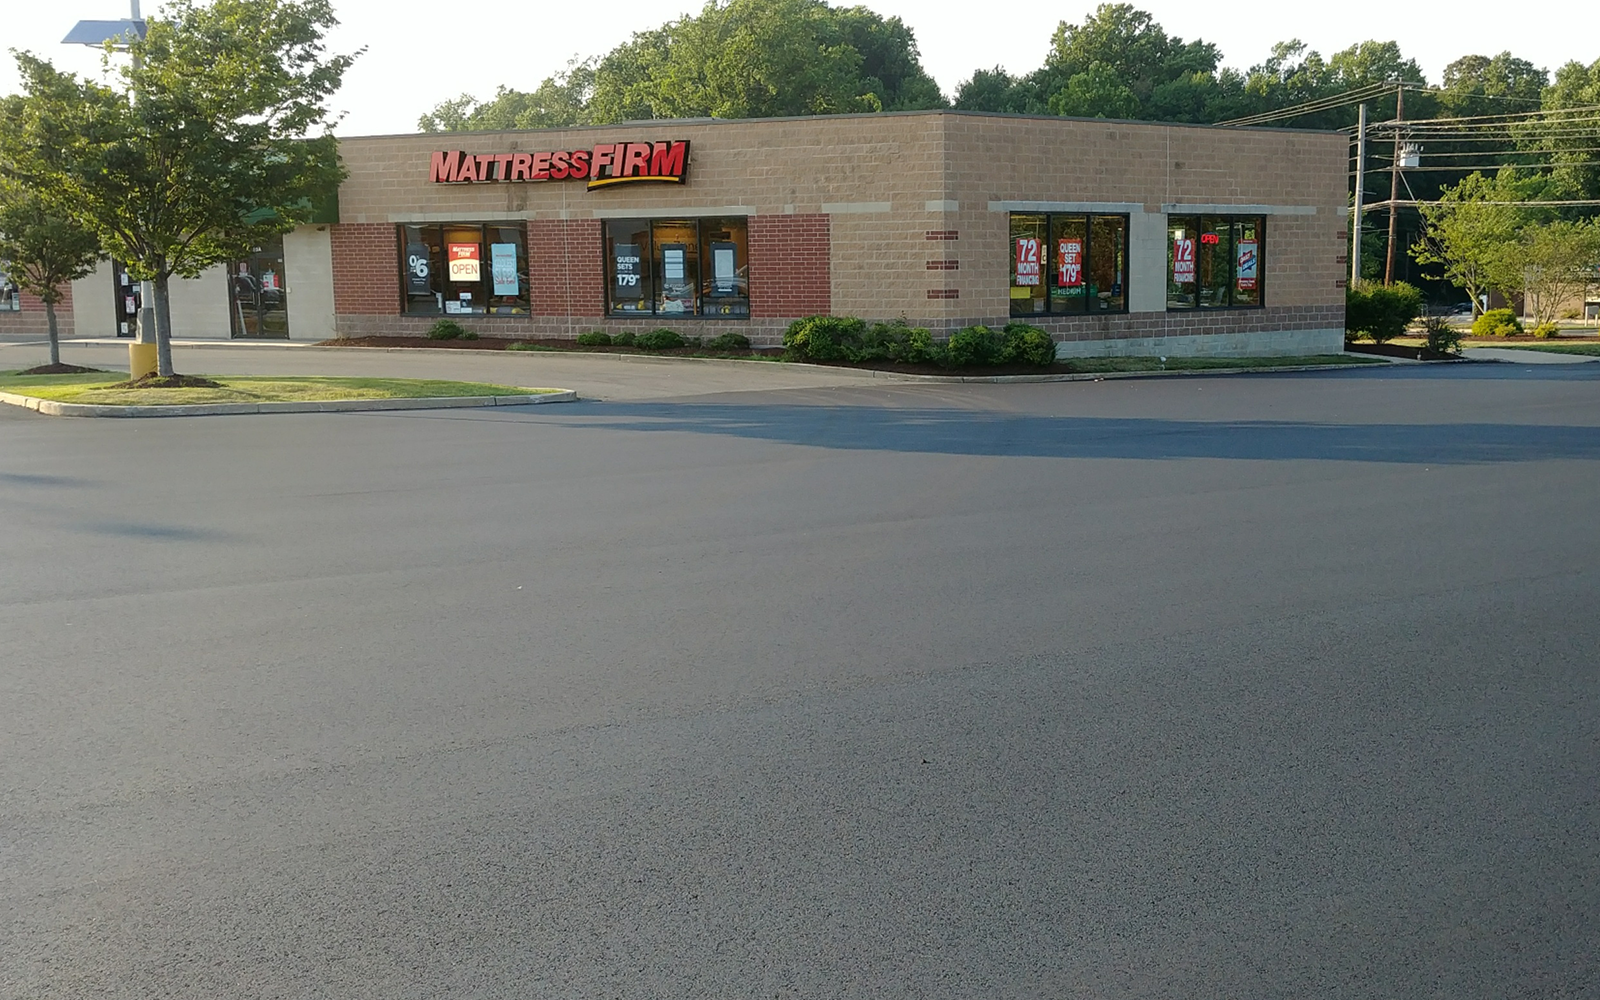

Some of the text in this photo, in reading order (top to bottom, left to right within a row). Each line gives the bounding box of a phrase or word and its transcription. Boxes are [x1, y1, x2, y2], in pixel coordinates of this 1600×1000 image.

[1019, 239, 1037, 262] 72
[1059, 243, 1081, 253] QUEEN
[1176, 239, 1192, 260] 72
[1064, 253, 1077, 263] SET
[415, 258, 428, 278] 6
[452, 263, 478, 275] OPEN
[1017, 262, 1039, 274] MONTH
[1175, 261, 1194, 273] MONTH
